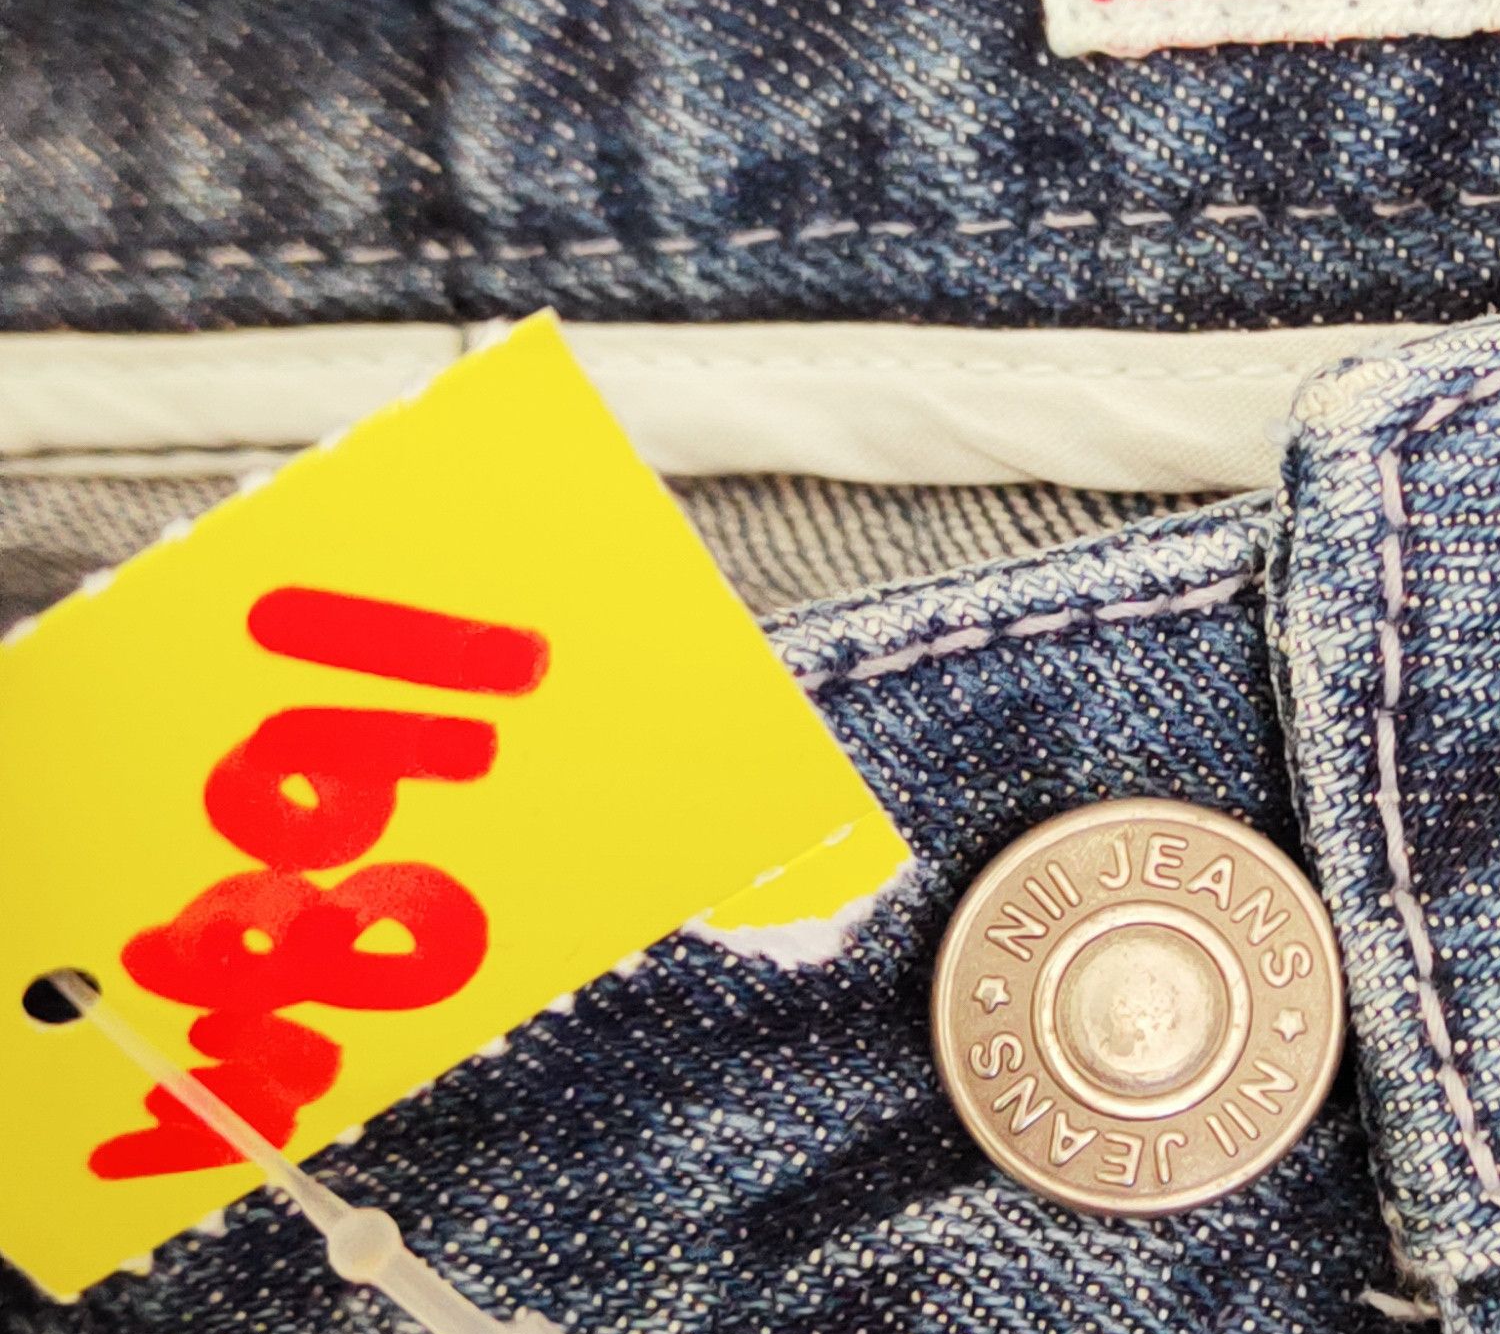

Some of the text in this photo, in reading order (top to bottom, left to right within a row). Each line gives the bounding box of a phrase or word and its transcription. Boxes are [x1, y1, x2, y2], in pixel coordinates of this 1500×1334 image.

[985, 832, 1313, 988] NII JEANS
[969, 1033, 1297, 1186] NII JEANS
